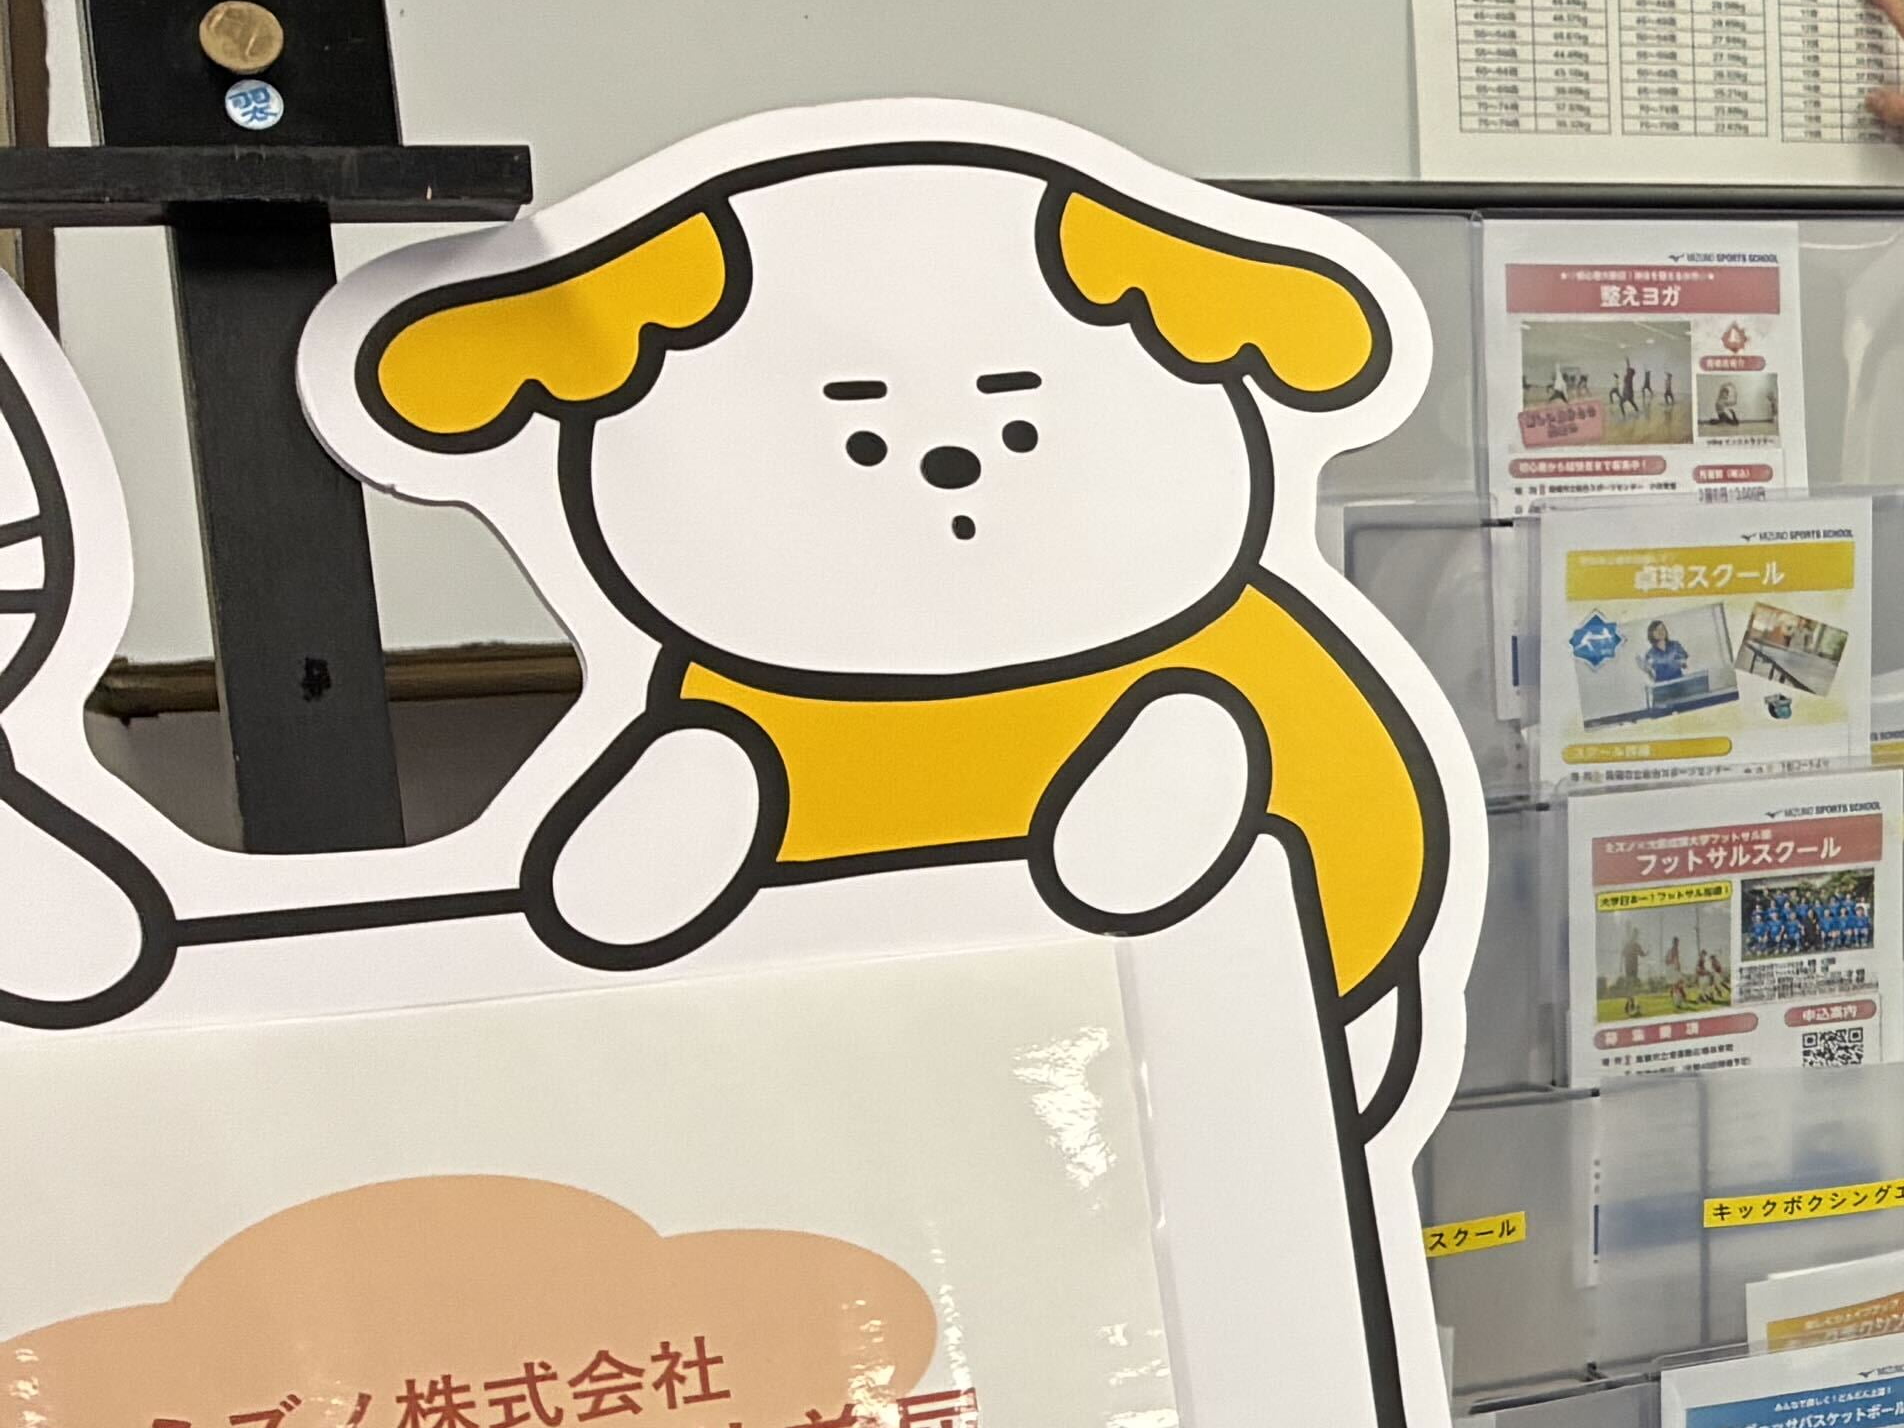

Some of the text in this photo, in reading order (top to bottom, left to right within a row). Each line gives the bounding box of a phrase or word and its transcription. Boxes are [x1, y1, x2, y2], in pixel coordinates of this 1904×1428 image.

[1599, 285, 1682, 308] 整えヨガ
[1633, 561, 1785, 593] 卓球スクール
[1636, 835, 1842, 877] フットサルスクール
[1427, 1220, 1518, 1252] スクール
